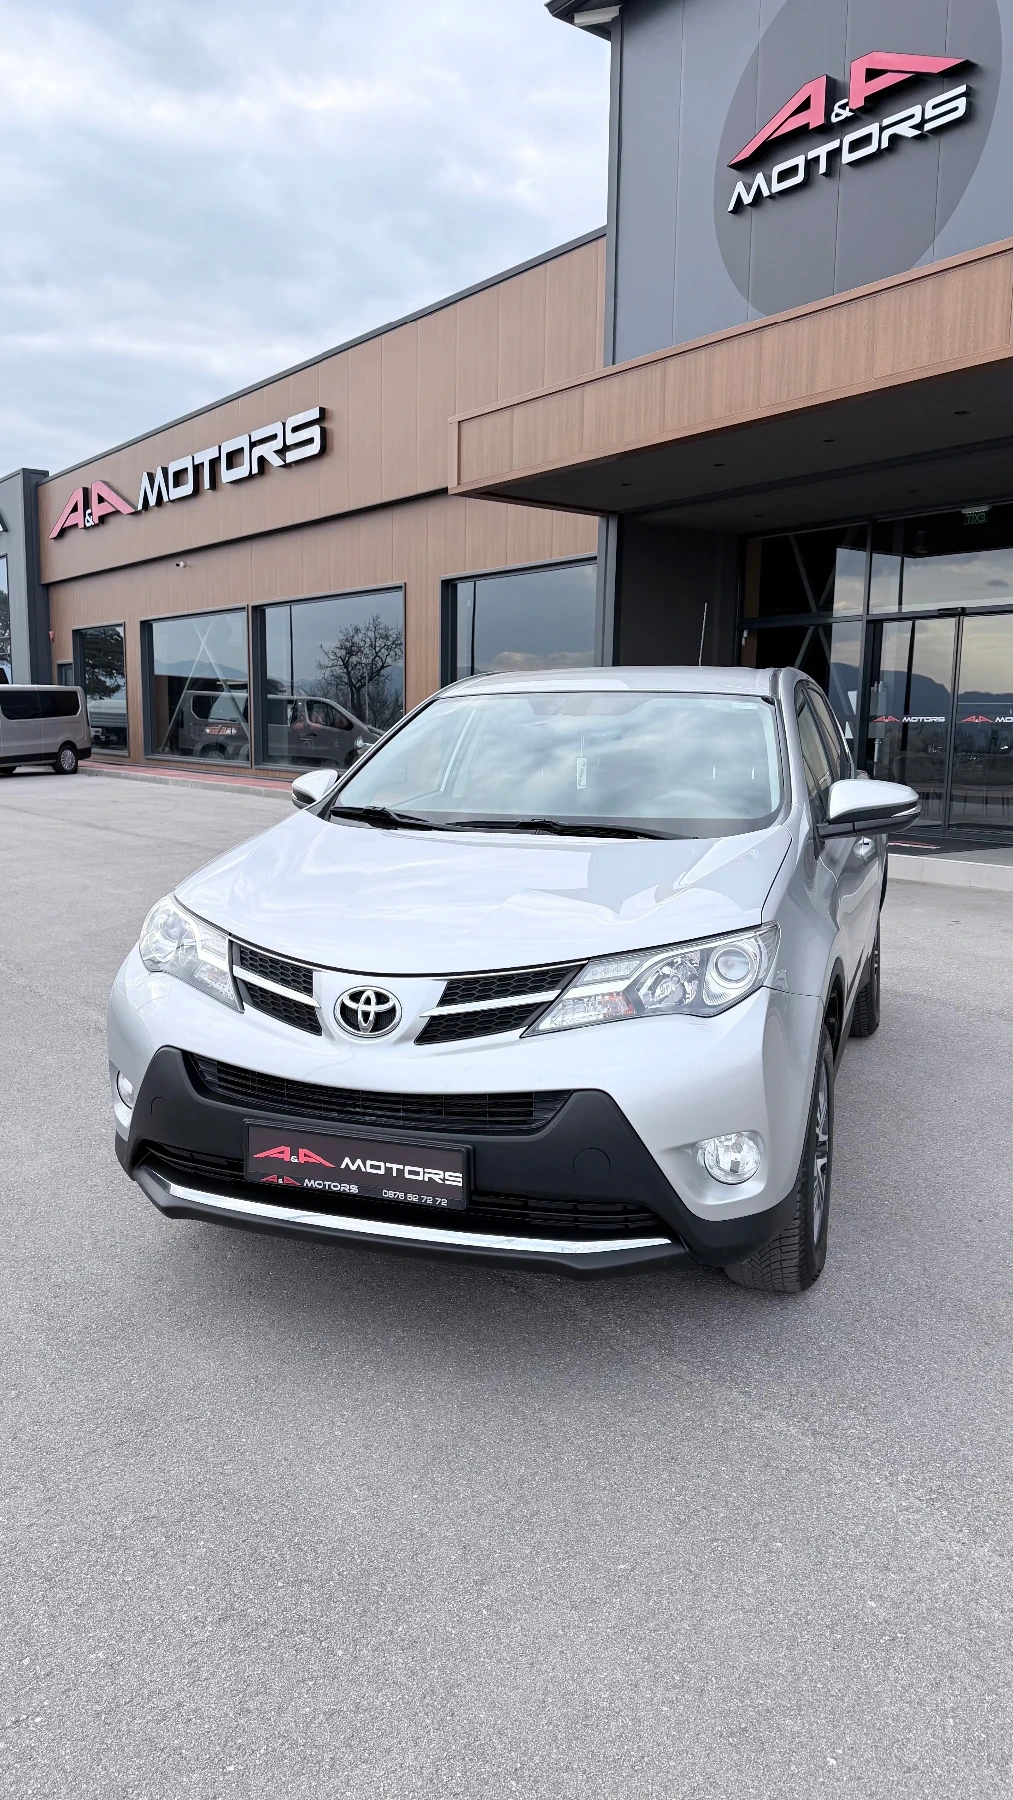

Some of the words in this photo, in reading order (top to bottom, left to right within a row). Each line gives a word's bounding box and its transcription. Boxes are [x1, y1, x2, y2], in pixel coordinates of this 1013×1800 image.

[728, 84, 968, 212] MOTORS
[137, 406, 322, 511] MOTORS
[303, 1178, 359, 1194] MOTORS
[382, 1189, 405, 1200] 0876
[420, 1195, 433, 1204] 72
[435, 1197, 448, 1206] 72
[340, 1156, 463, 1187] MOTORS
